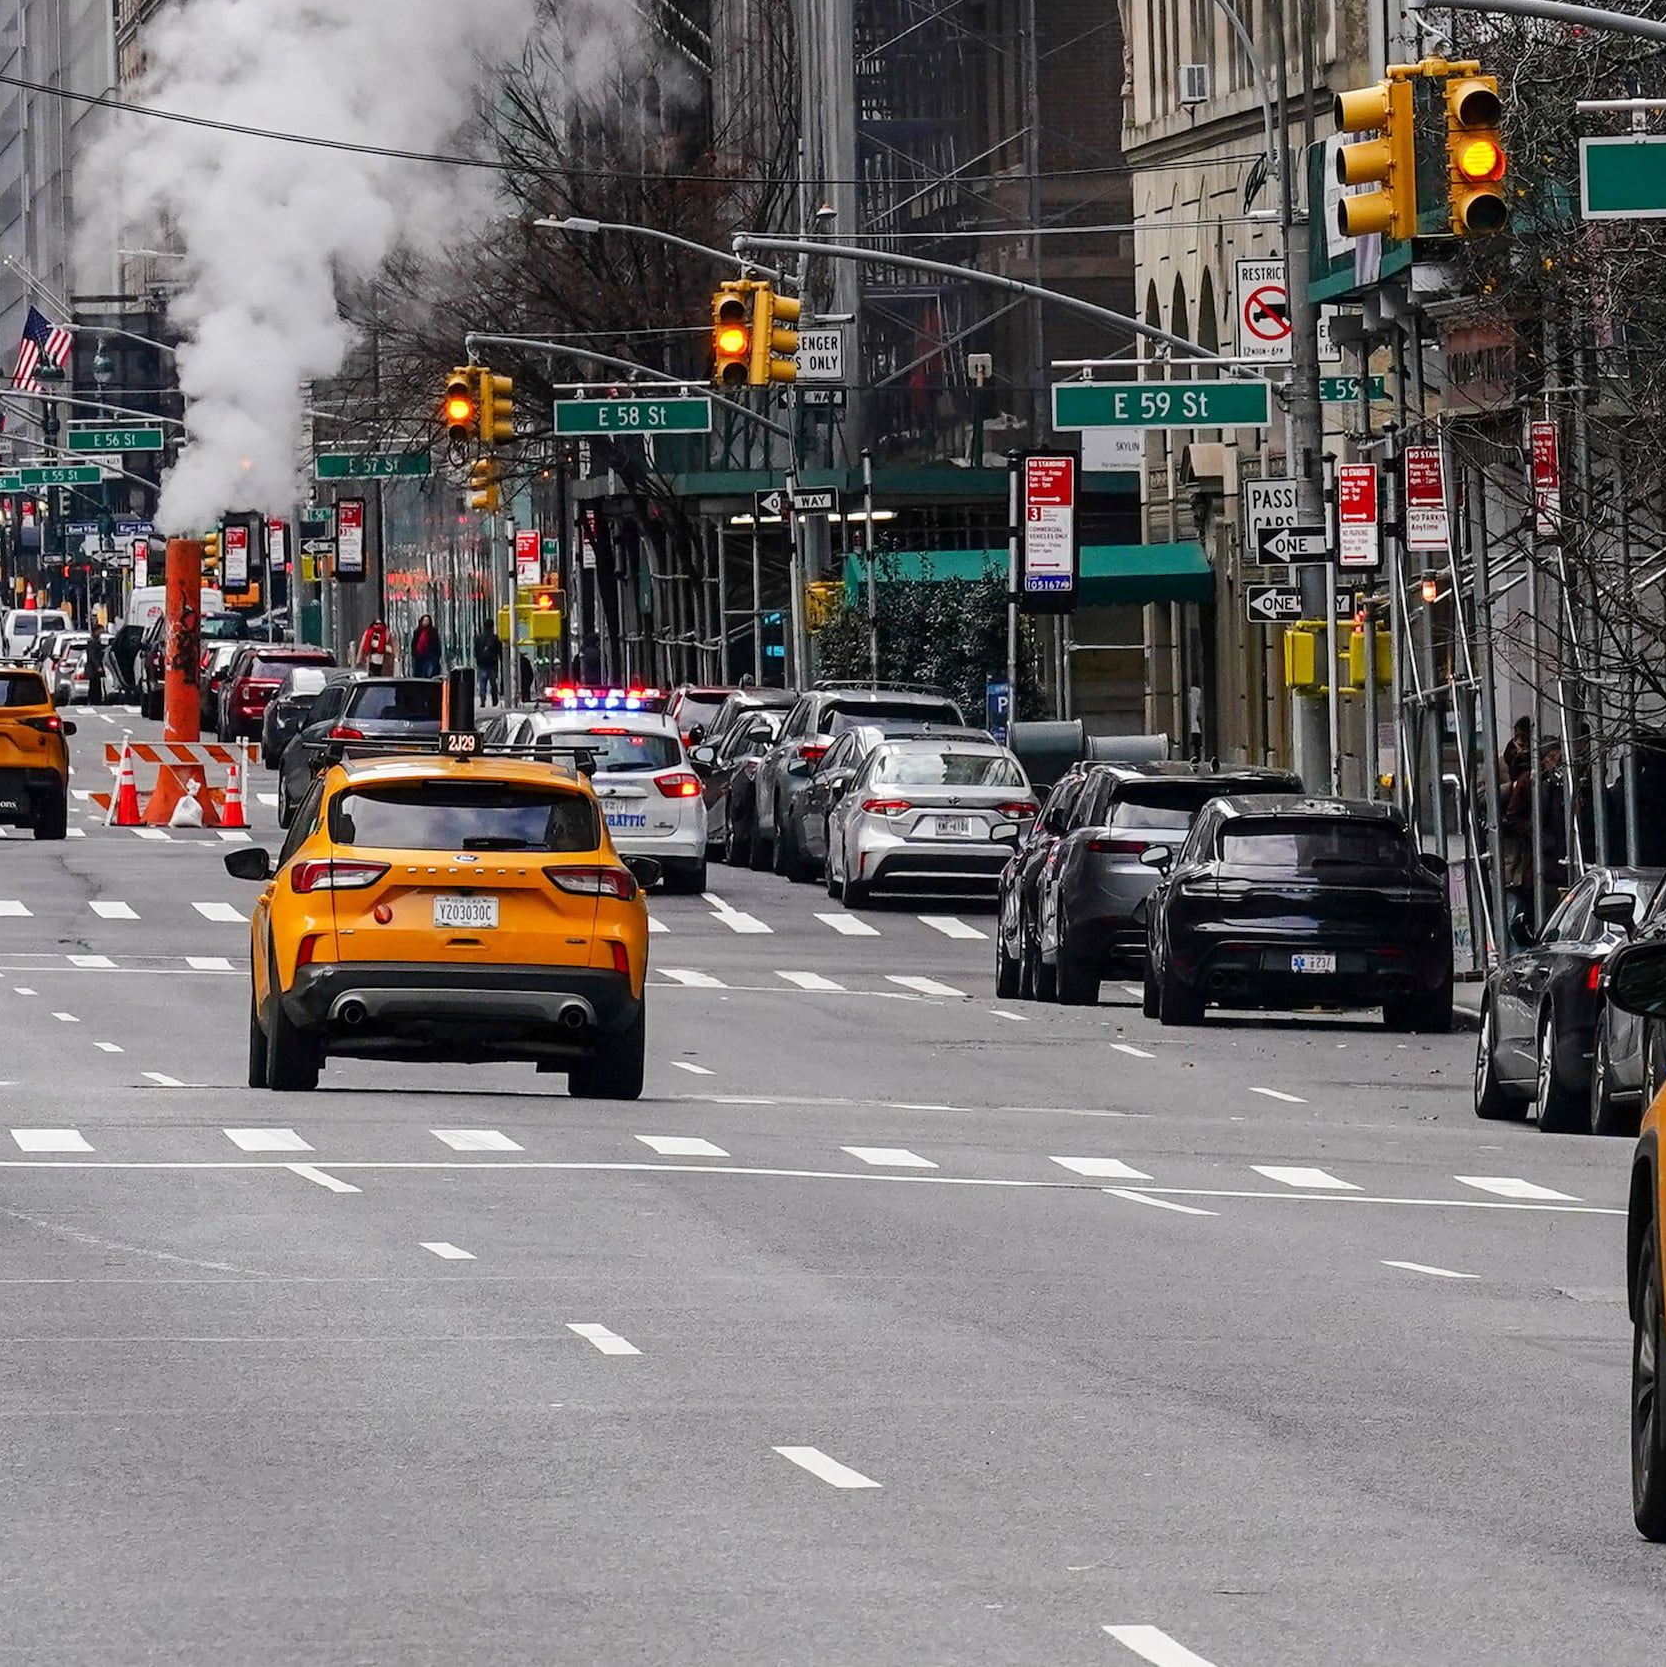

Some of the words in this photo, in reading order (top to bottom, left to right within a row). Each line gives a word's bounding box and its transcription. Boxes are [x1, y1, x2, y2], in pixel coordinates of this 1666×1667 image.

[809, 355, 838, 370] ONLY
[1335, 380, 1359, 399] 59
[1114, 392, 1129, 420] E
[1139, 390, 1171, 419] 59
[1182, 390, 1208, 419] St
[598, 409, 610, 426] E
[617, 407, 639, 426] 58
[648, 405, 667, 426] St
[94, 435, 100, 446] E
[105, 434, 120, 446] 56
[124, 434, 136, 446] St
[1408, 451, 1418, 459] NO
[385, 454, 399, 472] St
[42, 470, 48, 481] E
[52, 469, 64, 481] 55
[68, 469, 78, 481] St
[801, 495, 826, 507] WAY
[1030, 508, 1038, 520] 3
[1411, 523, 1439, 532] Anytime
[1275, 538, 1308, 553] ONE
[1263, 597, 1293, 611] ONE
[564, 698, 641, 709] NYPD
[998, 696, 1008, 713] P
[449, 735, 475, 752] 2J29
[439, 904, 492, 921] Y203030C
